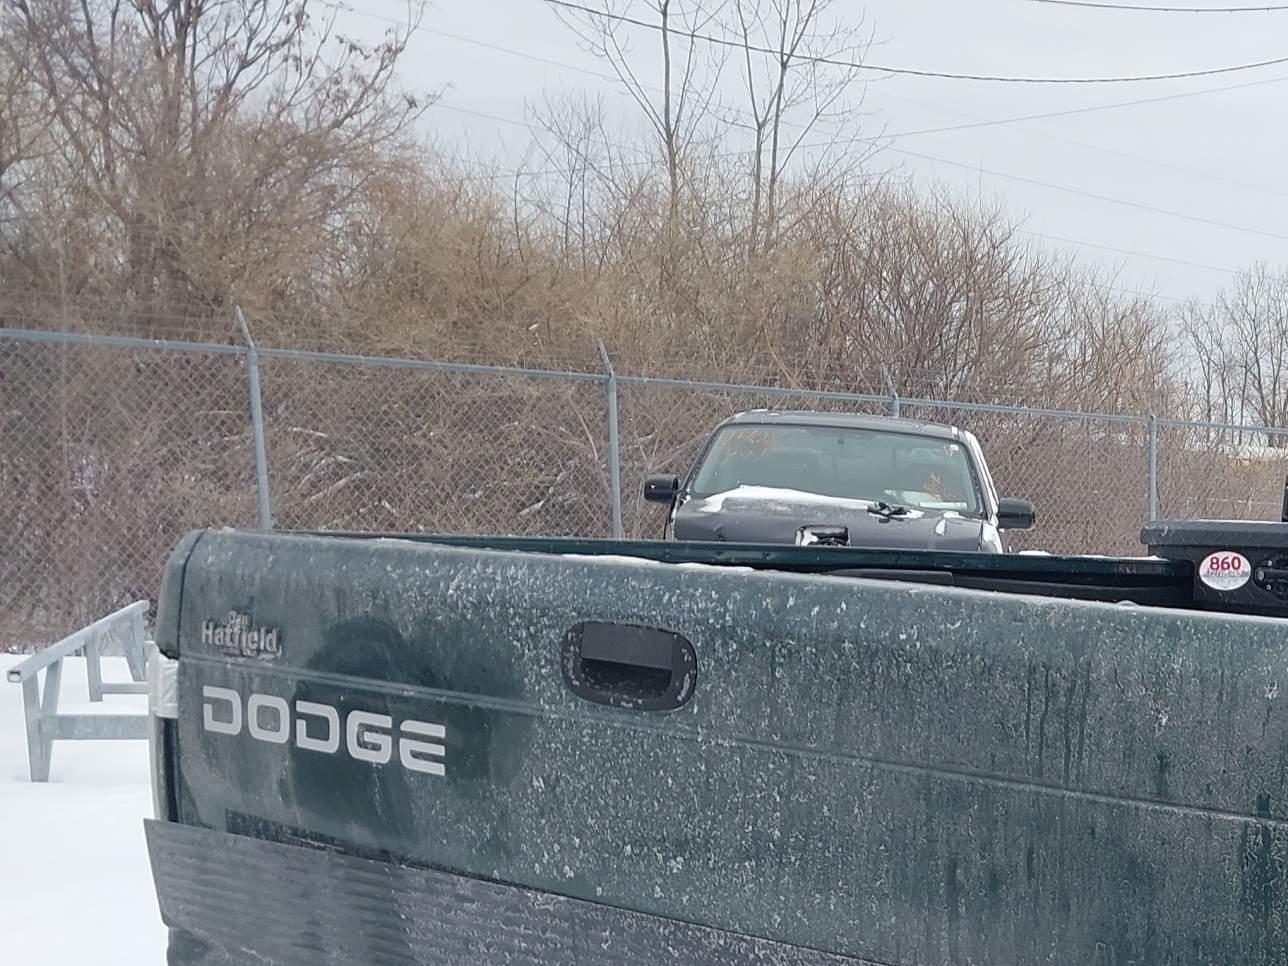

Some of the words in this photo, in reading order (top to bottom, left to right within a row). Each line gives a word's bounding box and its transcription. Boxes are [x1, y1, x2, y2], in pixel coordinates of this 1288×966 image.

[1209, 556, 1242, 571] 860
[201, 619, 278, 653] Hatfield
[202, 684, 447, 777] DODGE
